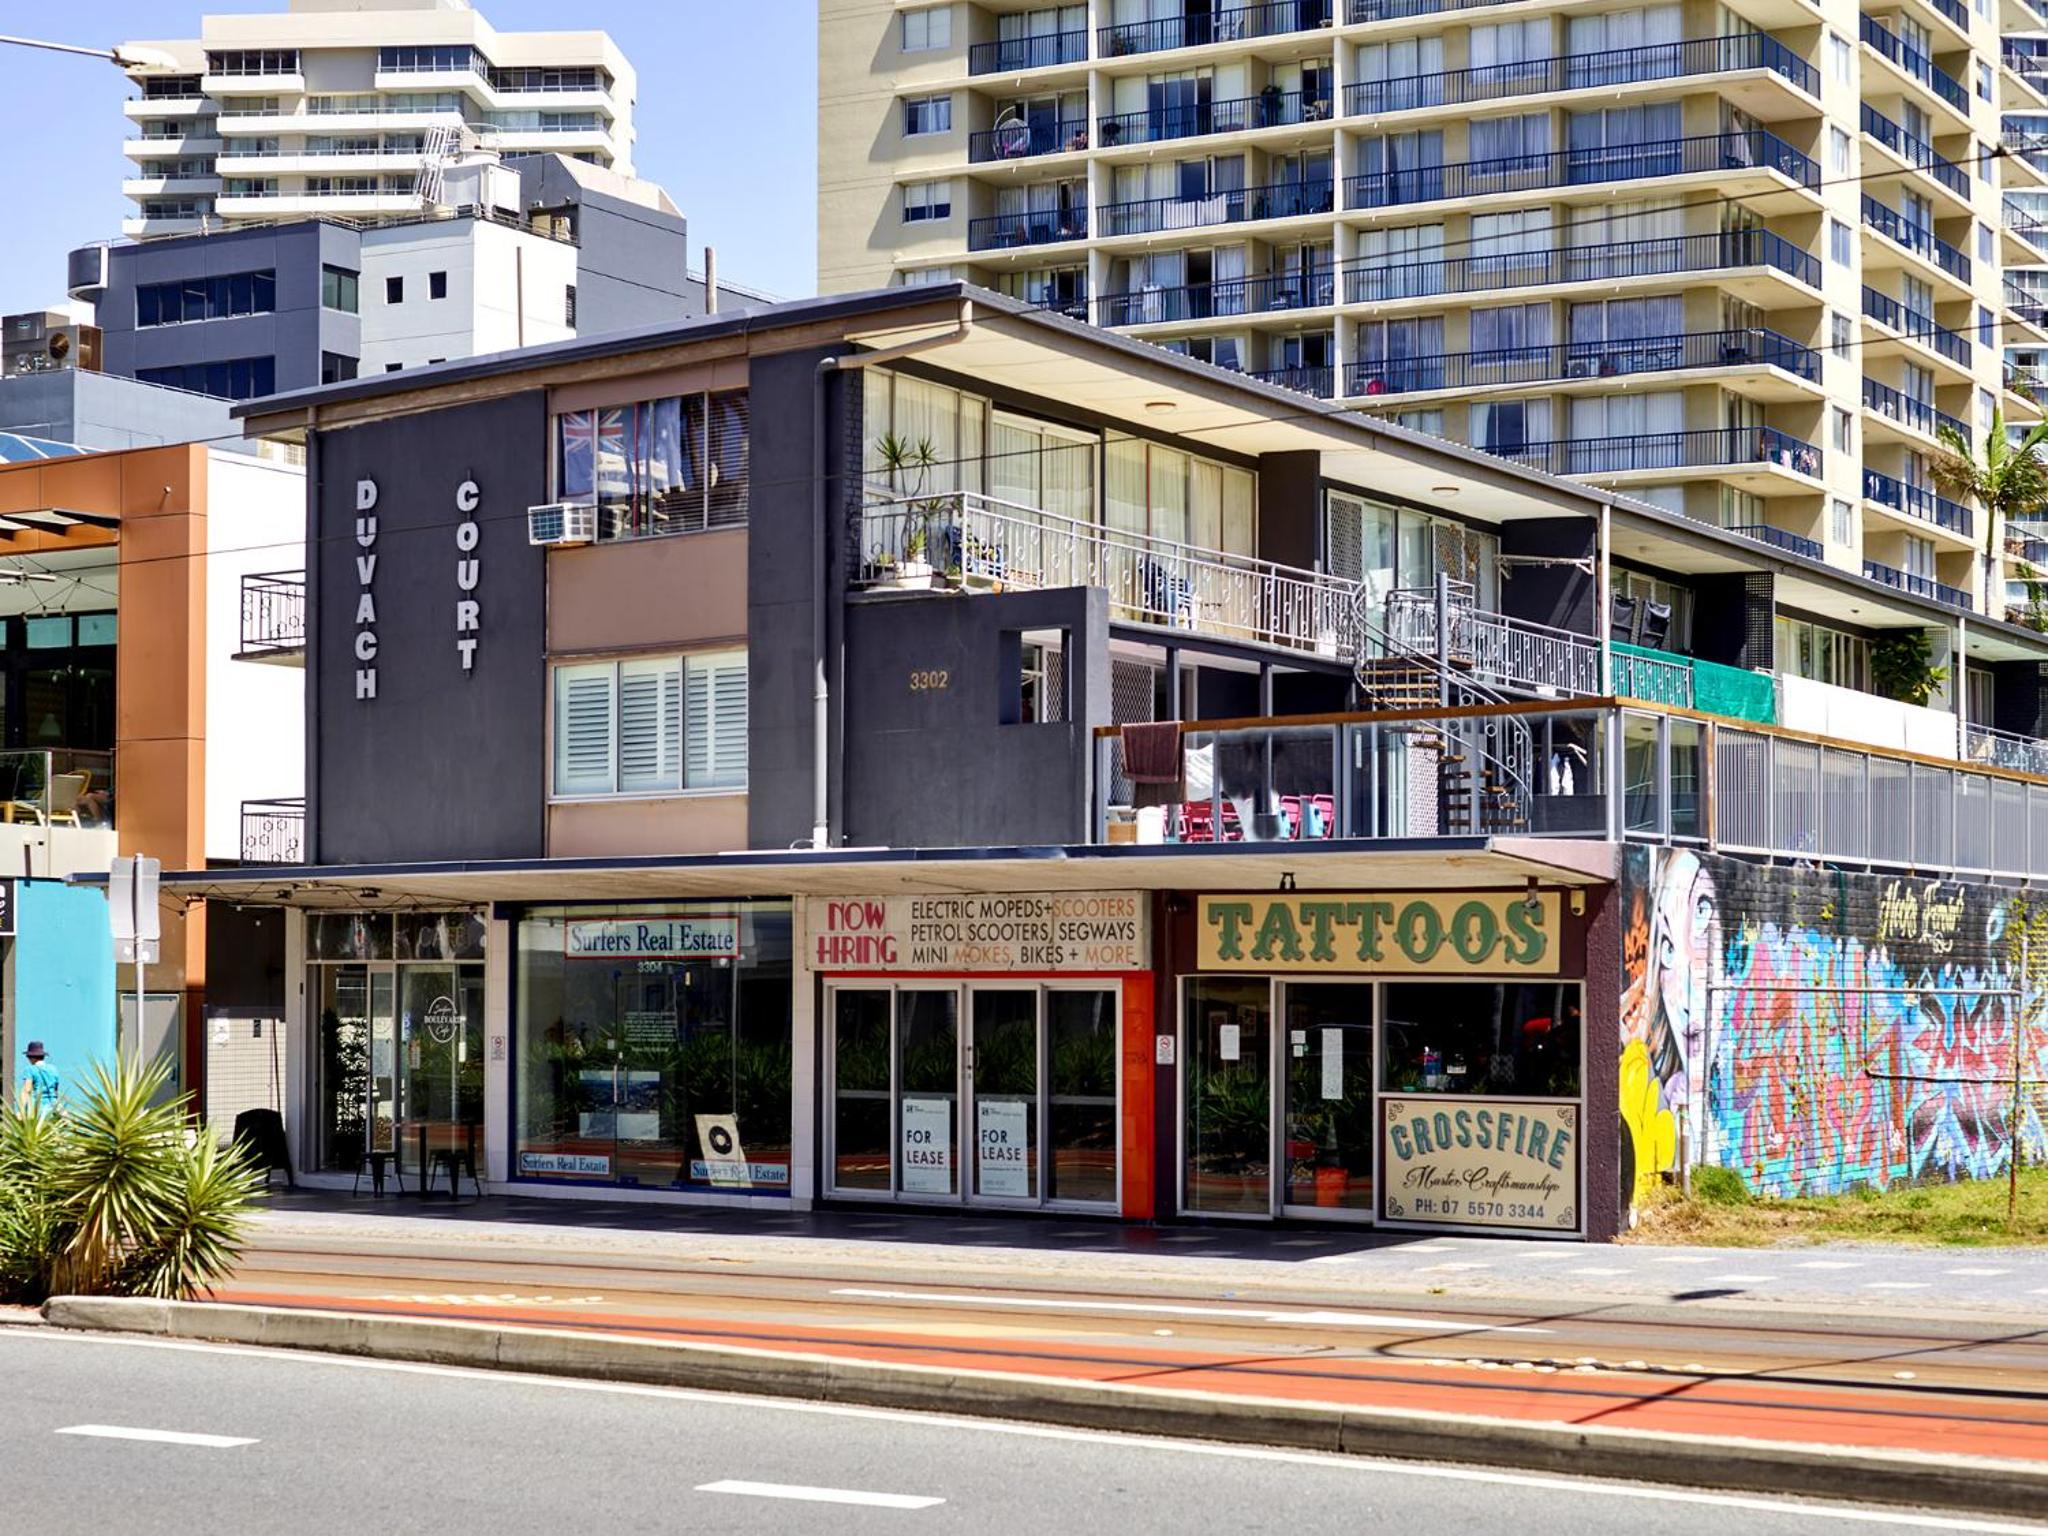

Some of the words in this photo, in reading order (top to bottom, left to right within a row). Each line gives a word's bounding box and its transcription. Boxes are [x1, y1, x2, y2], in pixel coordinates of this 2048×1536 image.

[456, 480, 480, 669] COURT
[356, 479, 378, 699] DUVACH
[910, 670, 948, 690] 3302
[828, 901, 885, 931] NOW
[911, 901, 975, 919] ELECTRIC
[571, 925, 631, 952] Surfers
[637, 923, 673, 951] Real
[679, 924, 733, 951] Estate
[911, 924, 963, 942] PETROL
[968, 923, 1054, 944] SCOOTERS,
[1059, 922, 1135, 941] SEGWAYS
[1208, 900, 1547, 964] TATTOOS
[817, 935, 897, 964] HIRING
[912, 946, 948, 963] MINI
[953, 945, 1015, 967] MOKES,
[1020, 946, 1064, 964] BIKES
[1084, 946, 1134, 963] MORE
[906, 1129, 932, 1143] FOR
[981, 1129, 1008, 1144] FOR
[1390, 1109, 1571, 1171] CROSSFIRE
[557, 1156, 577, 1170] Real
[579, 1157, 607, 1172] Estate
[906, 1150, 944, 1165] LEASE
[981, 1146, 1021, 1161] LEASE
[755, 1164, 786, 1181] Estate
[1403, 1164, 1462, 1190] Master
[1462, 1166, 1560, 1200] Craftsmanship
[1415, 1198, 1438, 1213] PH:
[1442, 1199, 1459, 1214] 07
[1468, 1201, 1504, 1216] 5570
[1508, 1203, 1545, 1219] 3344
